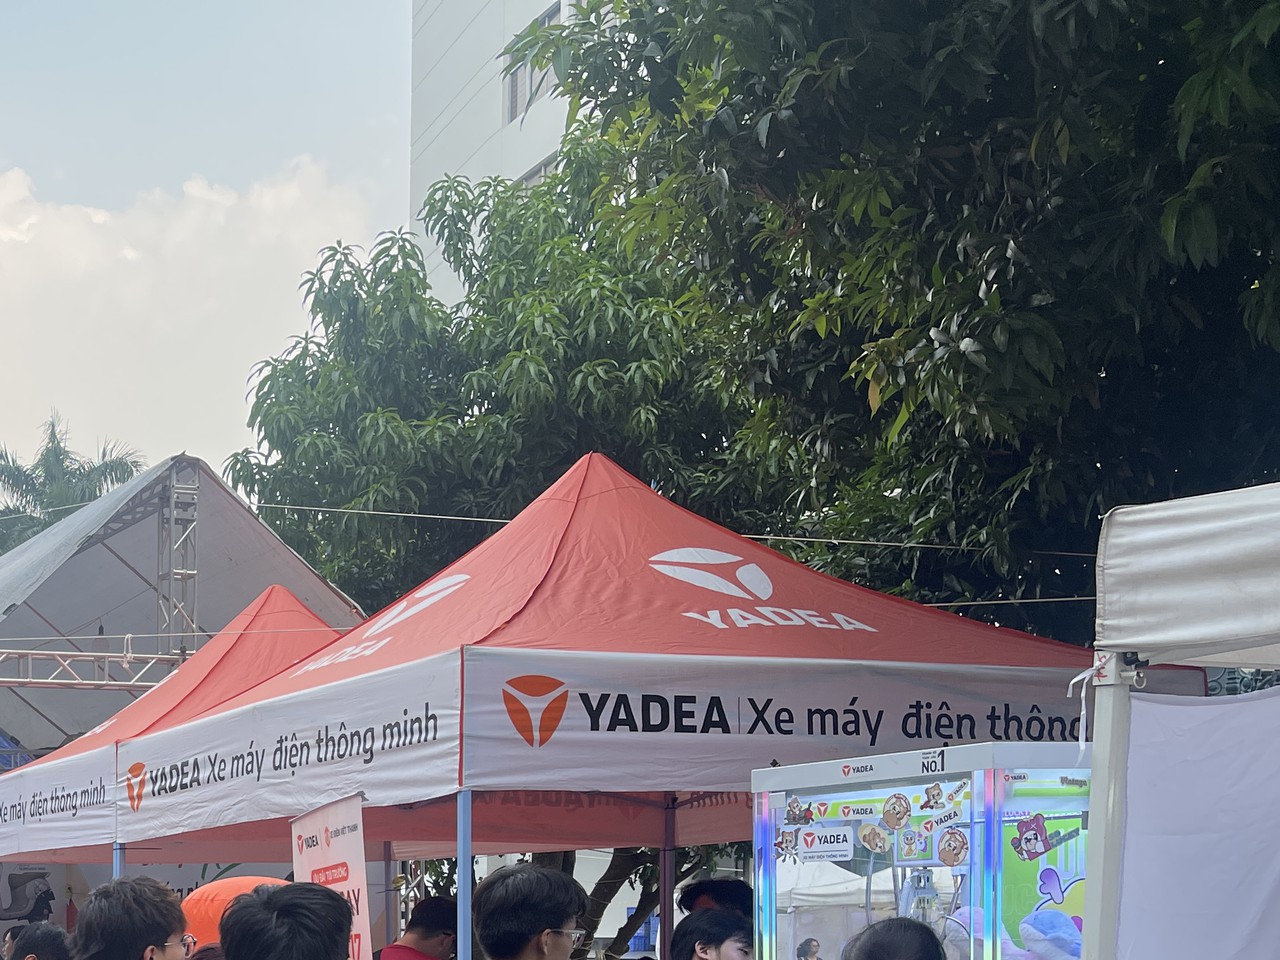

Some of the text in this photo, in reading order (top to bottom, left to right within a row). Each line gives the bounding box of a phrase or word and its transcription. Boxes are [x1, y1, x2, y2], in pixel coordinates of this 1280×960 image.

[681, 606, 879, 632] YADEA
[577, 692, 732, 735] YADEA
[747, 697, 795, 735] Xe
[807, 696, 884, 747] máy
[900, 700, 977, 748] điện
[150, 702, 438, 797] YADEA Xe máy điện thông minh
[852, 764, 874, 774] YADEA
[9, 794, 28, 825] máy
[29, 790, 48, 822] điện
[49, 786, 78, 817] thông
[79, 776, 106, 808] minh
[851, 808, 874, 816] YADEA
[934, 810, 959, 827] YADEA
[304, 834, 319, 849] YADEA
[817, 833, 849, 845] YADEA
